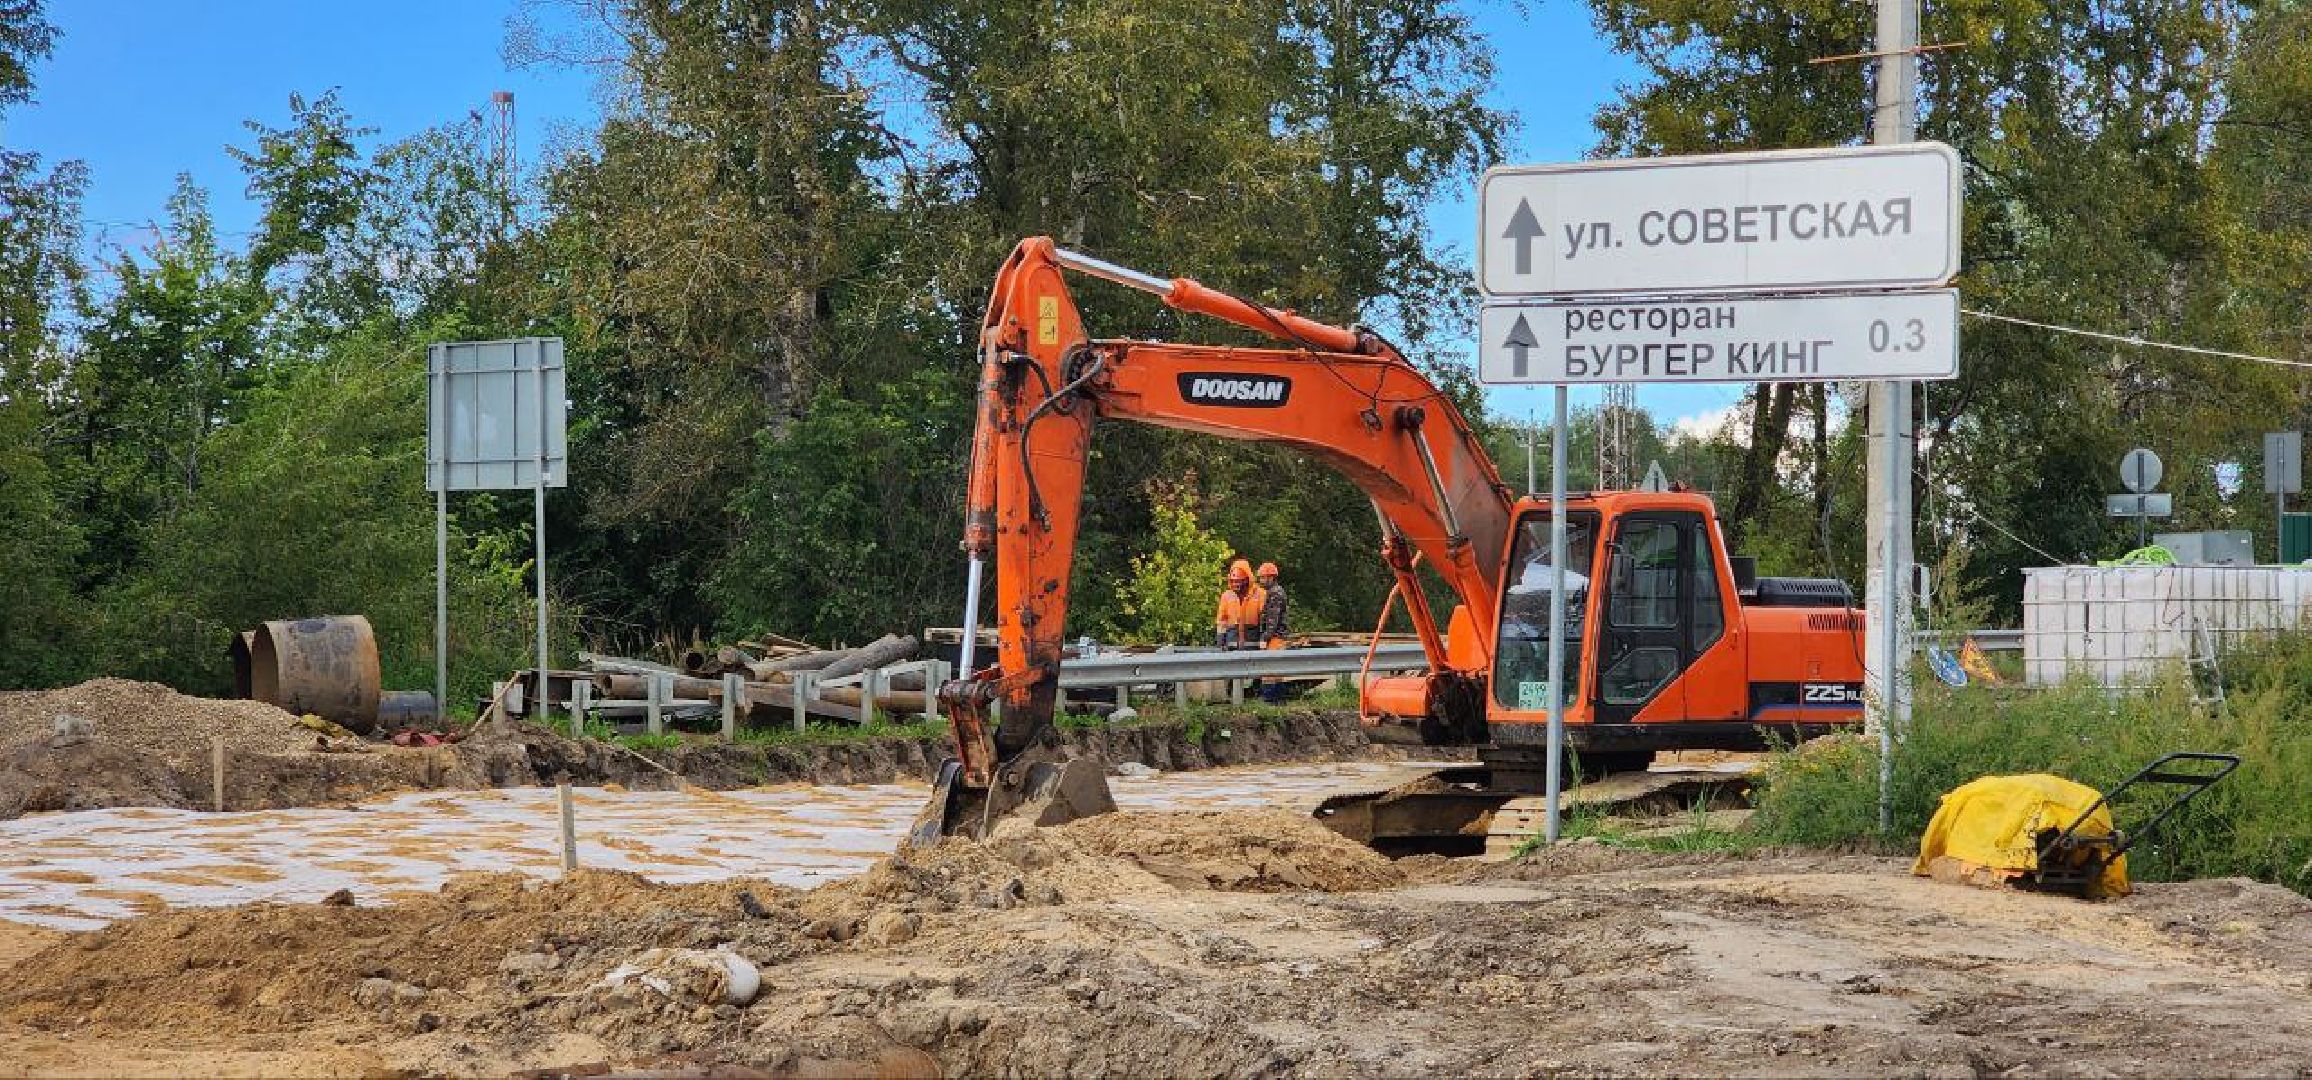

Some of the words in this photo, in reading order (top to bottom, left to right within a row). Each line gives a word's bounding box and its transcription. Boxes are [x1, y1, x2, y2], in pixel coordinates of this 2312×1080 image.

[1564, 221, 1623, 260] ул.
[1638, 196, 1913, 248] СОВЕТСКАЯ
[1564, 305, 1736, 340] ресторан
[1868, 317, 1926, 353] 0.3
[1564, 344, 1715, 377] БУРГЕР
[1726, 339, 1834, 374] КИНГ
[1191, 378, 1284, 401] DOOSAN
